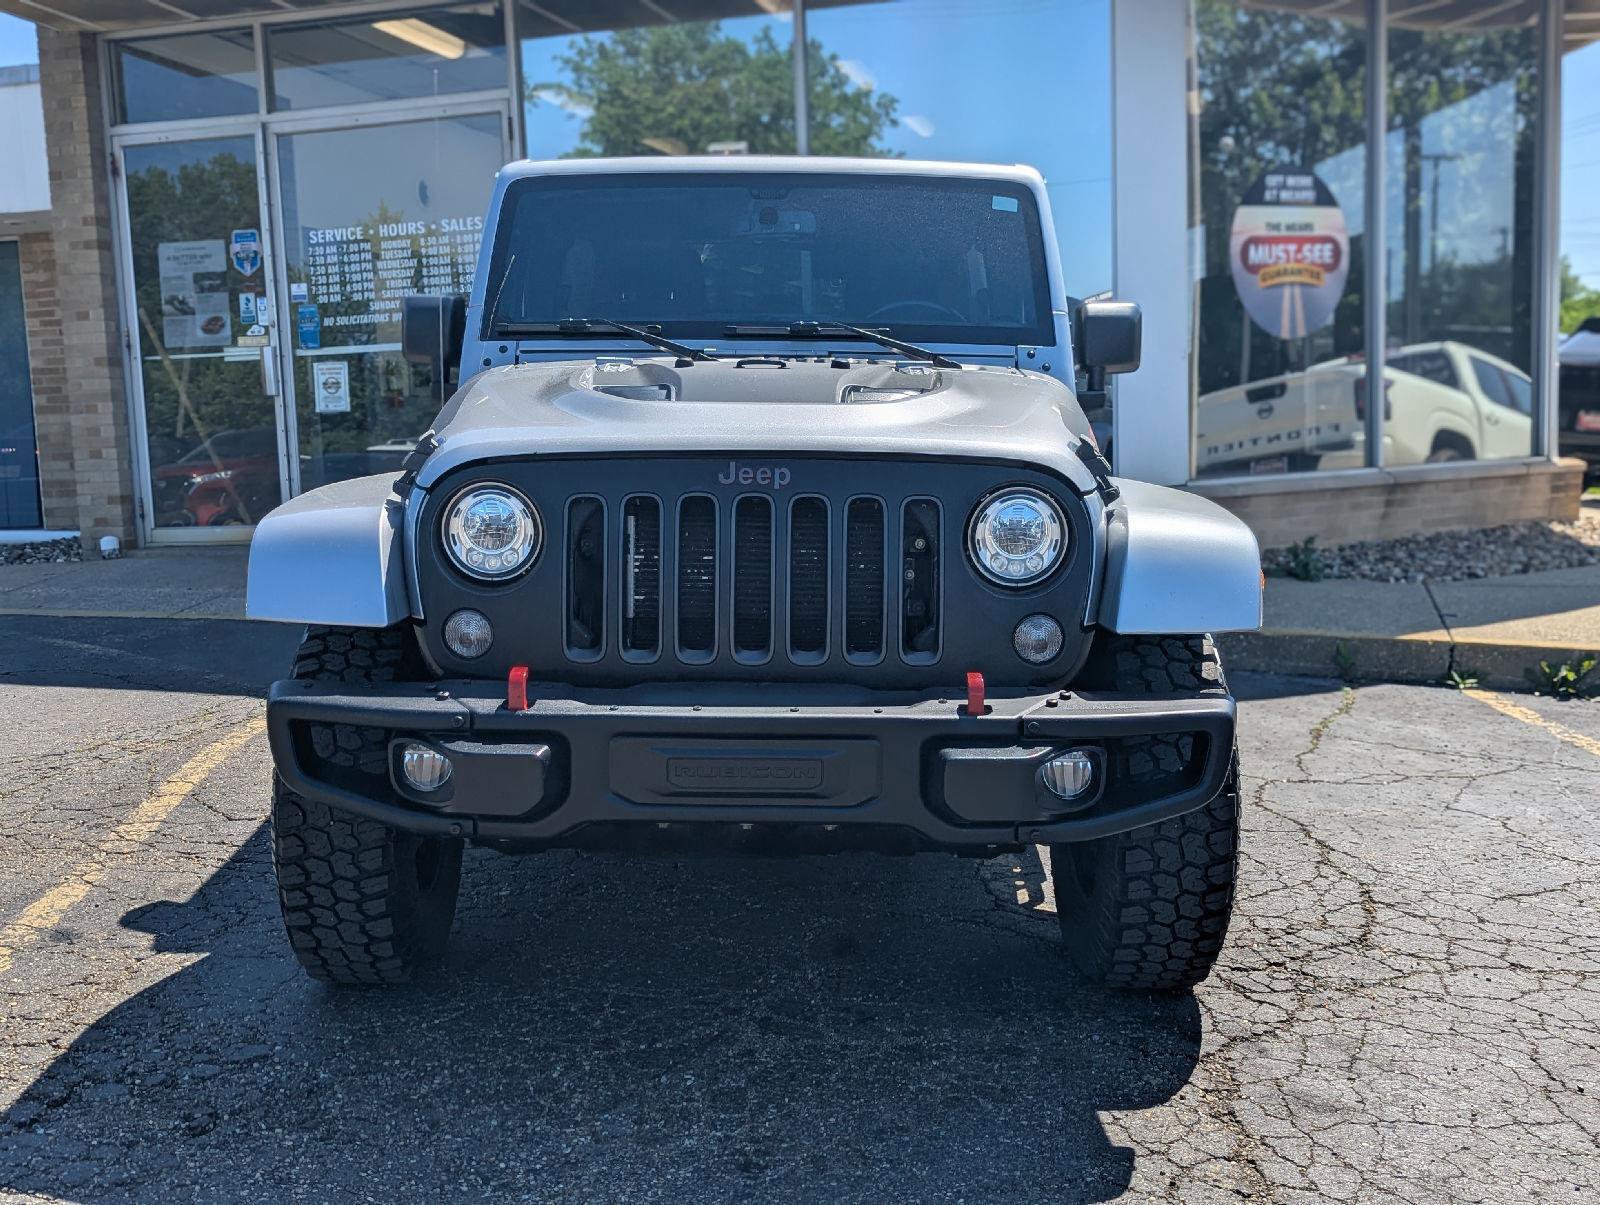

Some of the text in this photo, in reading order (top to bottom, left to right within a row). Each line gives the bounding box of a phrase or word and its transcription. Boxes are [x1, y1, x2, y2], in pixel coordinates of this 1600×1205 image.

[309, 216, 483, 244] SERVICE HOURS SALES
[1265, 222, 1281, 232] THE
[326, 245, 337, 254] AM
[360, 242, 371, 250] PM
[381, 240, 410, 248] MONDAY
[1248, 243, 1334, 265] MUST-SEE
[309, 256, 324, 264] 7:30
[326, 255, 338, 263] AM
[361, 252, 372, 260] PM
[382, 249, 412, 259] TUESDAY
[327, 265, 339, 273] AM
[362, 262, 372, 270] PM
[377, 258, 417, 269] WEDNESDAY
[440, 256, 450, 264] AM
[311, 276, 327, 284] 7:30
[329, 274, 340, 283] AM
[363, 272, 373, 280] PM
[379, 268, 414, 278] THURSDAY
[440, 266, 451, 274] AM
[1261, 267, 1321, 281] GUARANTEE
[311, 286, 328, 294] 7:30
[329, 284, 340, 292] AM
[363, 282, 374, 290] PM
[387, 279, 411, 288] FRIDAY
[440, 275, 451, 284] AM
[330, 294, 341, 302] AM
[364, 291, 375, 299] PM
[382, 288, 418, 298] SATURDAY
[460, 284, 473, 292] 3:0
[369, 301, 400, 310] SUNDAY
[324, 317, 334, 326] NO
[336, 312, 388, 326] SOLICITATIONS
[718, 461, 791, 489] Jeep
[675, 766, 817, 779] RUBICON
